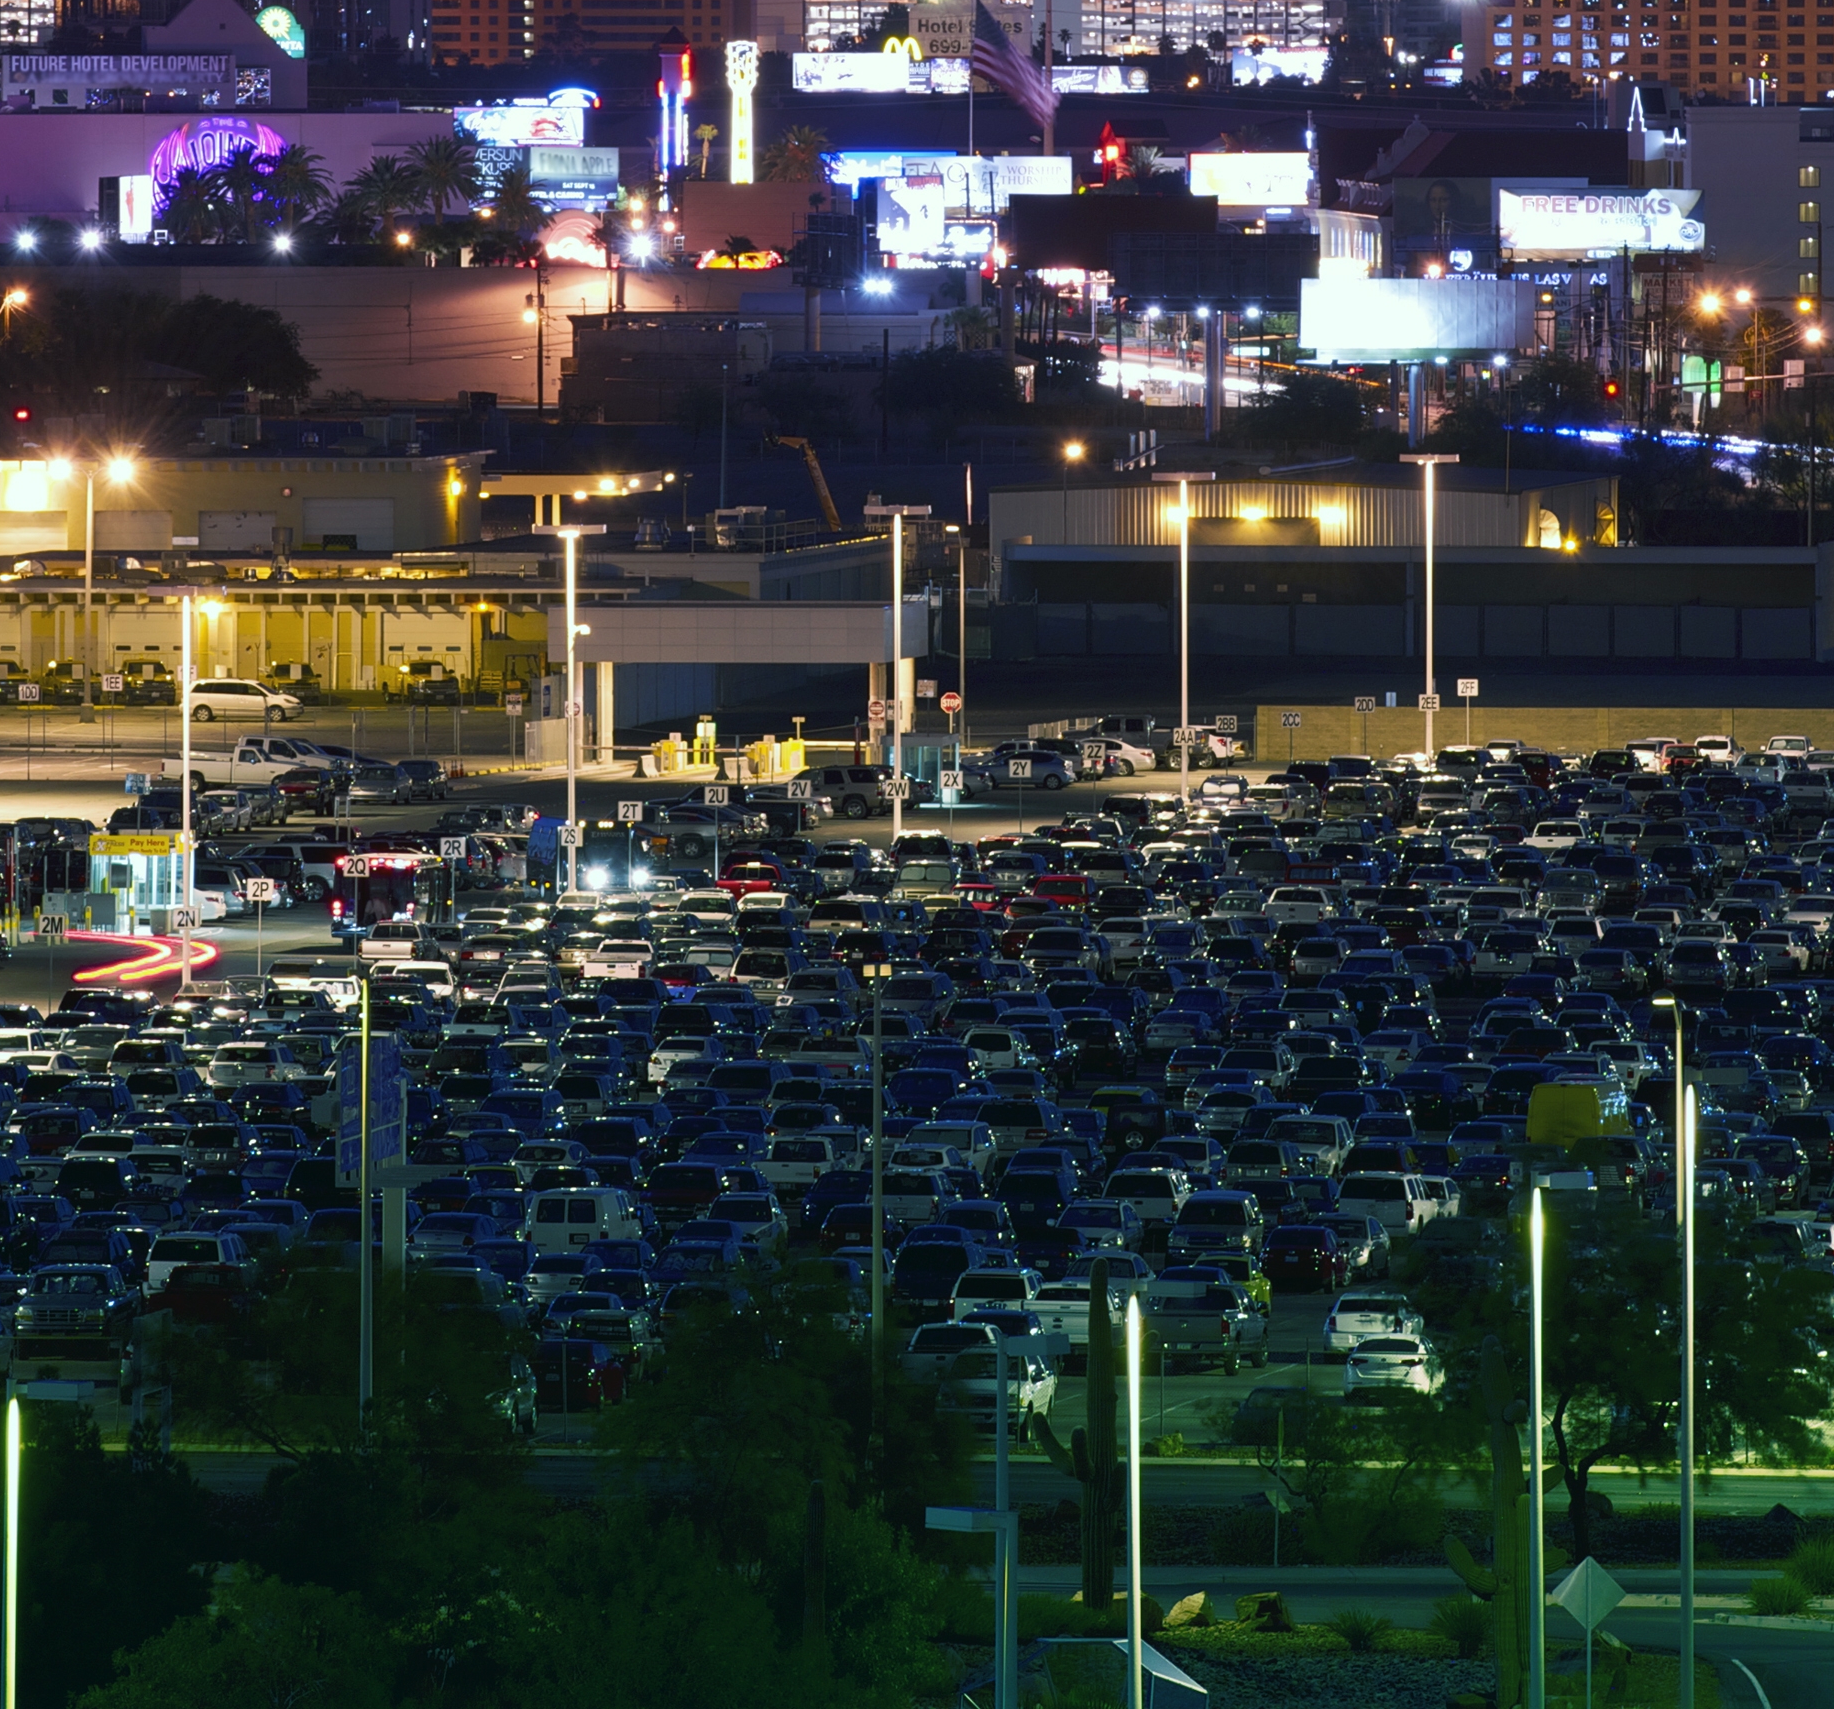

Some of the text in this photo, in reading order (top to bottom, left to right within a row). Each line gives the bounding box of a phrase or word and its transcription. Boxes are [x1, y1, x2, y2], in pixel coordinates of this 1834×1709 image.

[917, 19, 963, 35] Hotel
[12, 55, 229, 72] FUTURE HOTEL DEVELOPMENT
[212, 117, 234, 127] THE
[581, 156, 615, 175] APPLE
[1006, 165, 1062, 176] WORSHIP
[1522, 196, 1673, 215] FREE DRINKS
[1534, 273, 1560, 285] LAS
[1643, 278, 1692, 287] MAKET
[105, 676, 120, 689] 1EE
[1461, 681, 1475, 694] 2FF
[21, 686, 37, 699] 1DD
[942, 699, 960, 707] STOP
[1357, 698, 1374, 711] 2DD
[1421, 697, 1437, 709] 2EE
[1218, 718, 1235, 731] 2BB
[1283, 714, 1299, 727] 2CC
[1175, 730, 1194, 744] 2AA
[1087, 745, 1102, 758] 2Z
[1012, 762, 1028, 776] 2Y
[943, 773, 959, 787] 2X
[708, 788, 725, 804] 2U
[791, 781, 808, 797] 2V
[887, 782, 907, 797] 2W
[622, 803, 638, 819] 2T
[130, 838, 145, 847] Pay
[564, 828, 576, 844] 2S
[444, 840, 462, 856] 2R
[347, 858, 366, 876] 2Q
[252, 881, 269, 898] 2P
[42, 916, 63, 934] 2M
[177, 910, 195, 927] 2N
